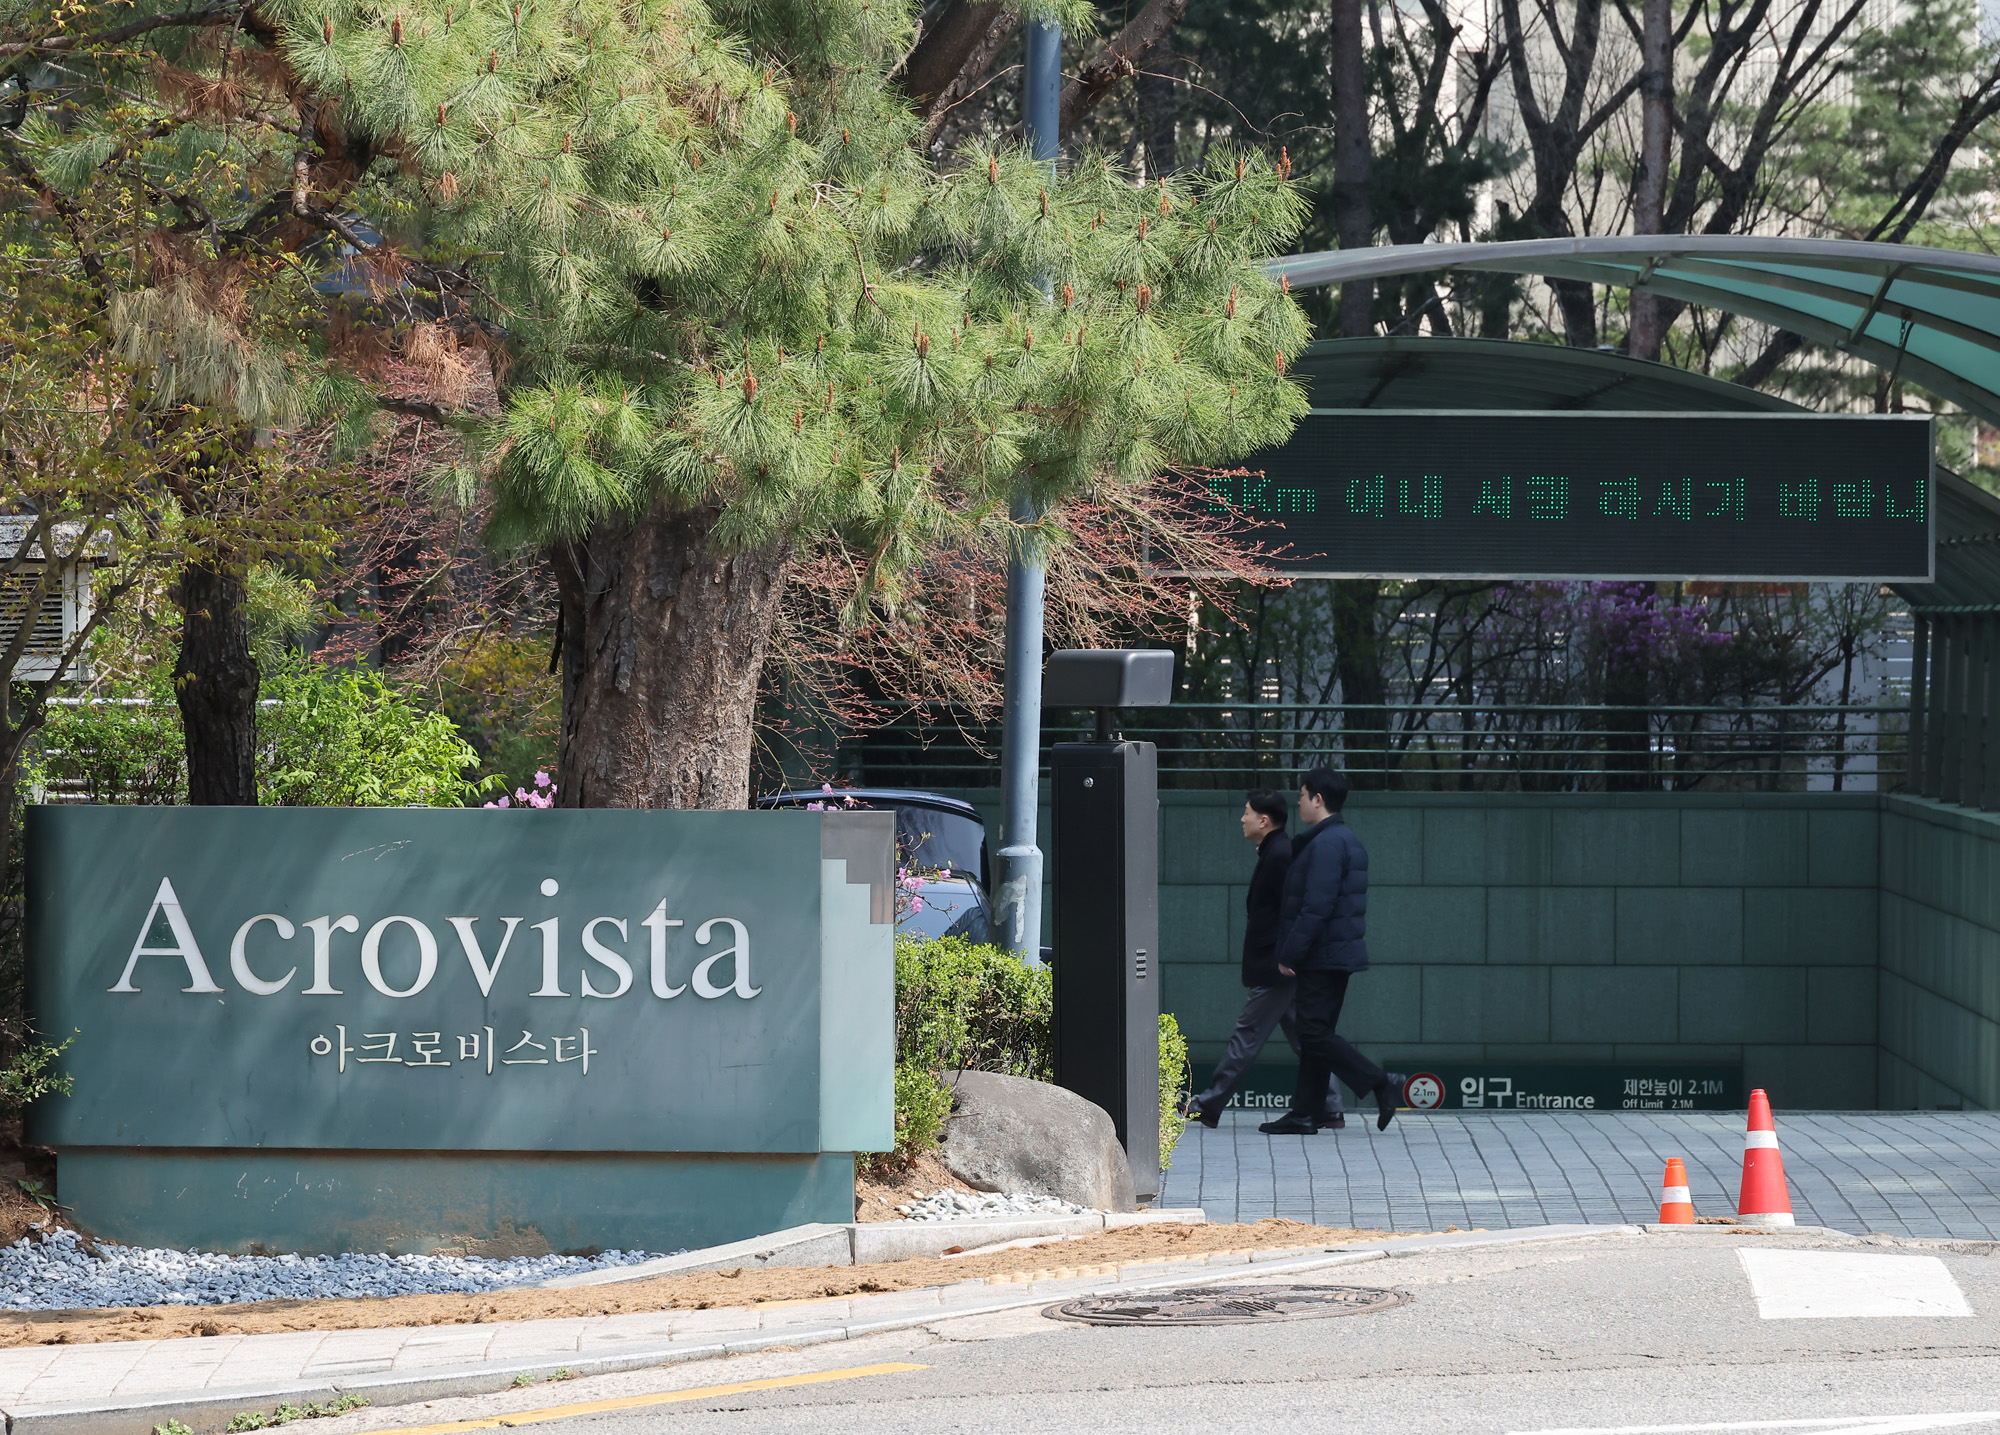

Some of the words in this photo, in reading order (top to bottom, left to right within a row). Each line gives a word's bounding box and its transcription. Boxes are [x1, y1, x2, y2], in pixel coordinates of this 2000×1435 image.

[1345, 473, 1443, 518] 이내
[1598, 476, 1745, 521] 하시기
[106, 876, 764, 1000] Acrovista
[309, 1024, 599, 1076] 아크로비스타
[1244, 1090, 1292, 1108] Enter
[1412, 1086, 1437, 1098] 2.1m
[1460, 1077, 1513, 1108] 입구
[1515, 1091, 1595, 1110] Entrance
[1623, 1078, 1683, 1097] 제한높이
[1688, 1079, 1724, 1095] 2.1M
[1640, 1099, 1664, 1110] Limit
[1671, 1099, 1694, 1110] 2.1M
